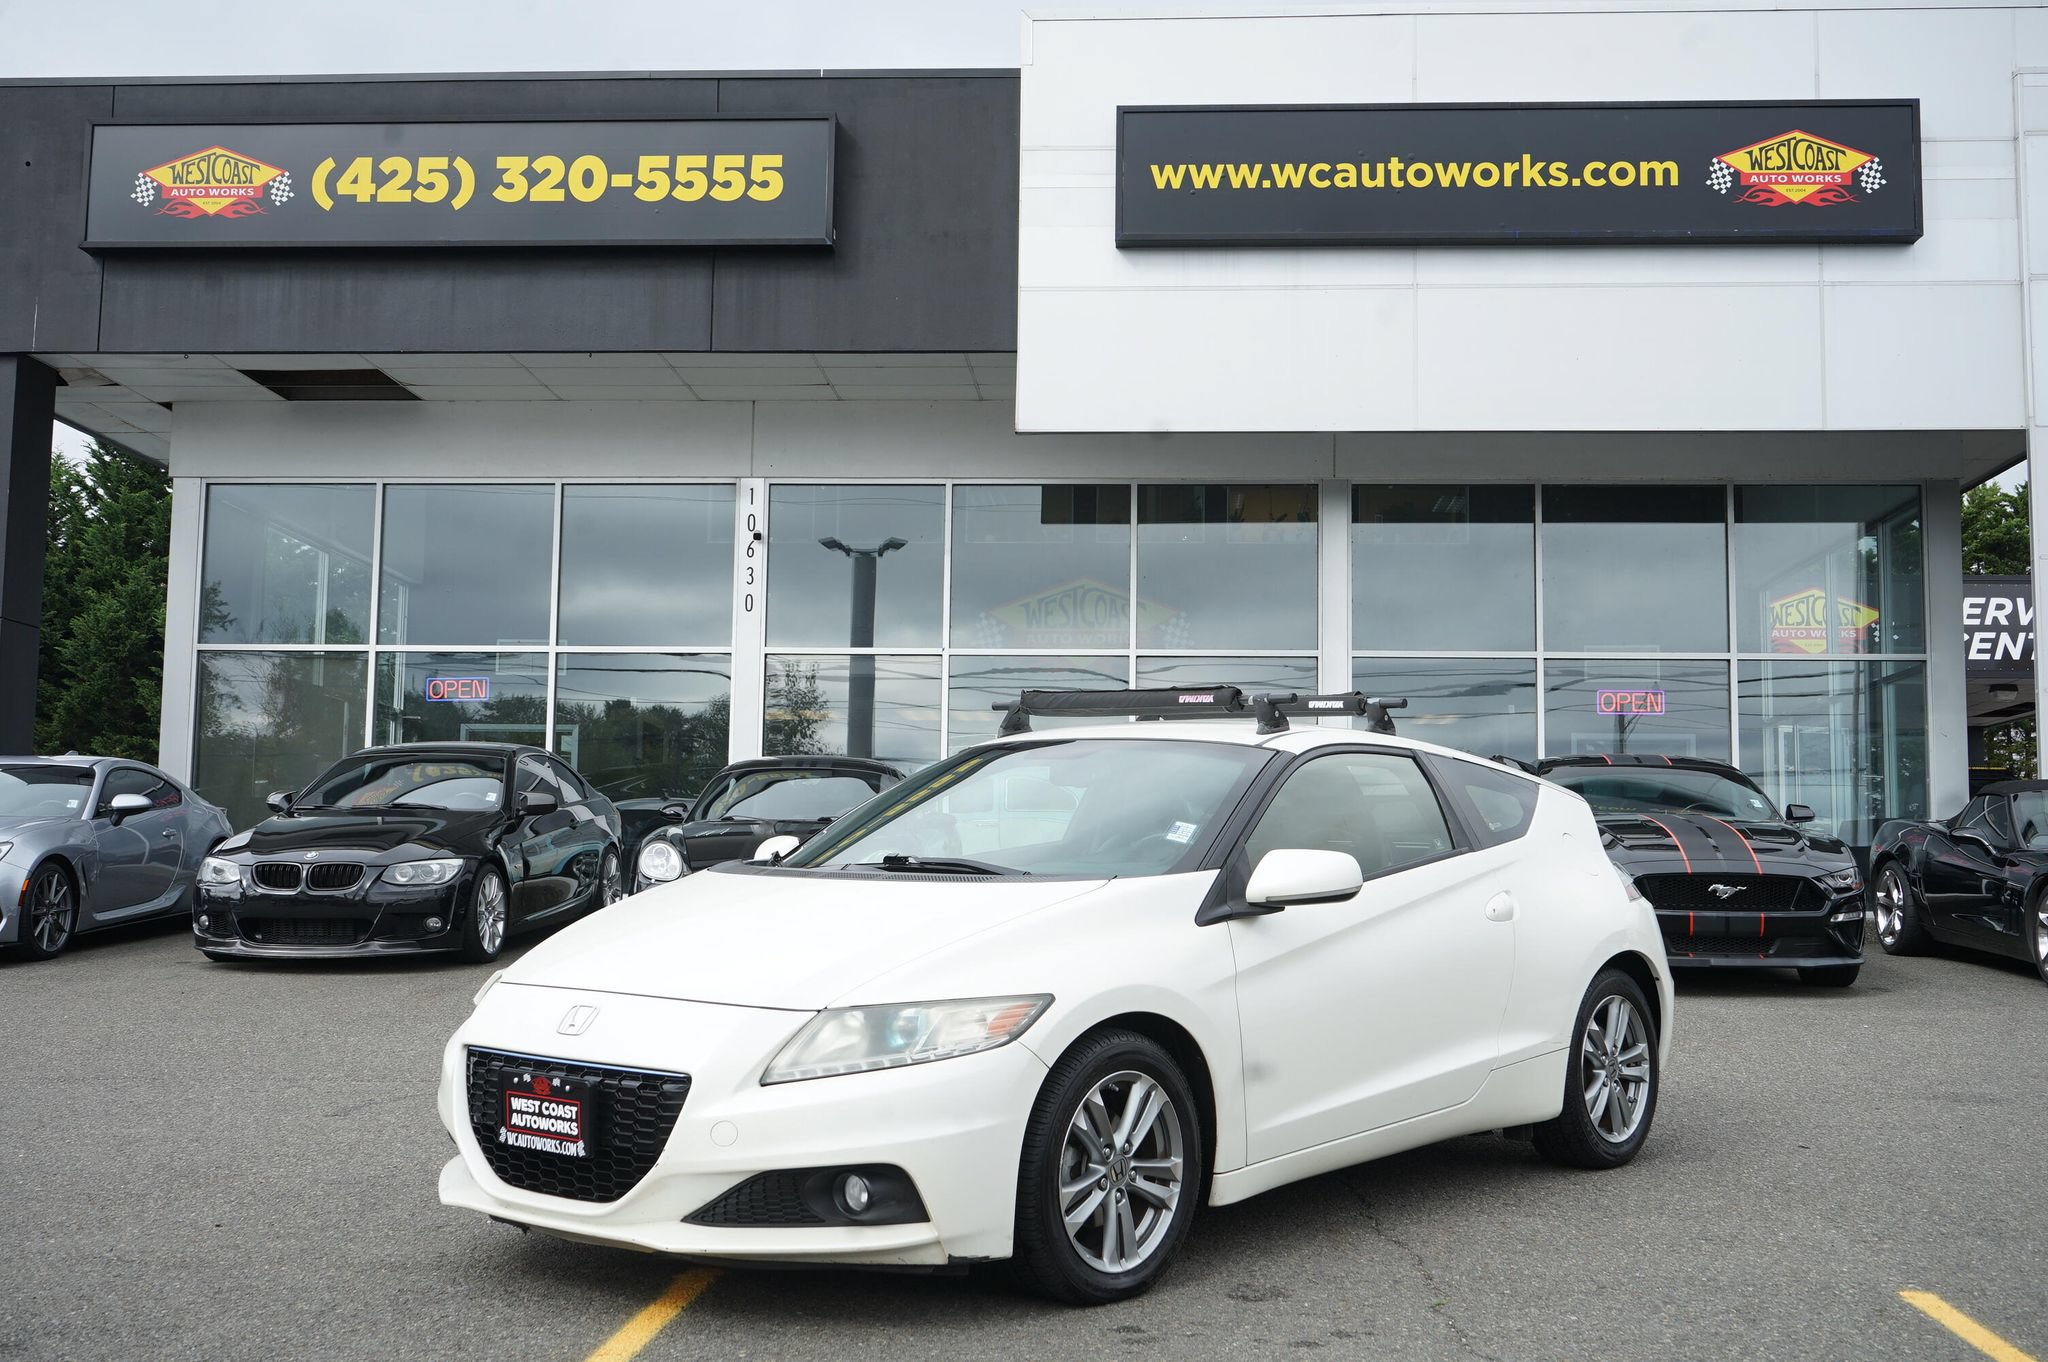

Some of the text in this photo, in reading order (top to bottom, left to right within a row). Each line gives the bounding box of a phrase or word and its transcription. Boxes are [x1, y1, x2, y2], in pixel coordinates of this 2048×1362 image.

[311, 155, 785, 211] (425) 320-5555
[1150, 153, 1679, 190] www.wcautoworks.com
[1750, 174, 1842, 183] AUTO WORKS
[171, 188, 254, 196] AUTO WORKS
[1771, 629, 1857, 638] AUTO WKS
[1963, 632, 2035, 660] EN
[429, 680, 486, 699] OPEN
[1600, 692, 1662, 712] OPEN
[511, 1097, 578, 1120] WEST COAST
[511, 1112, 578, 1136] AUTOWORKS
[507, 1132, 577, 1157] WCAUTOWORKS.COM
